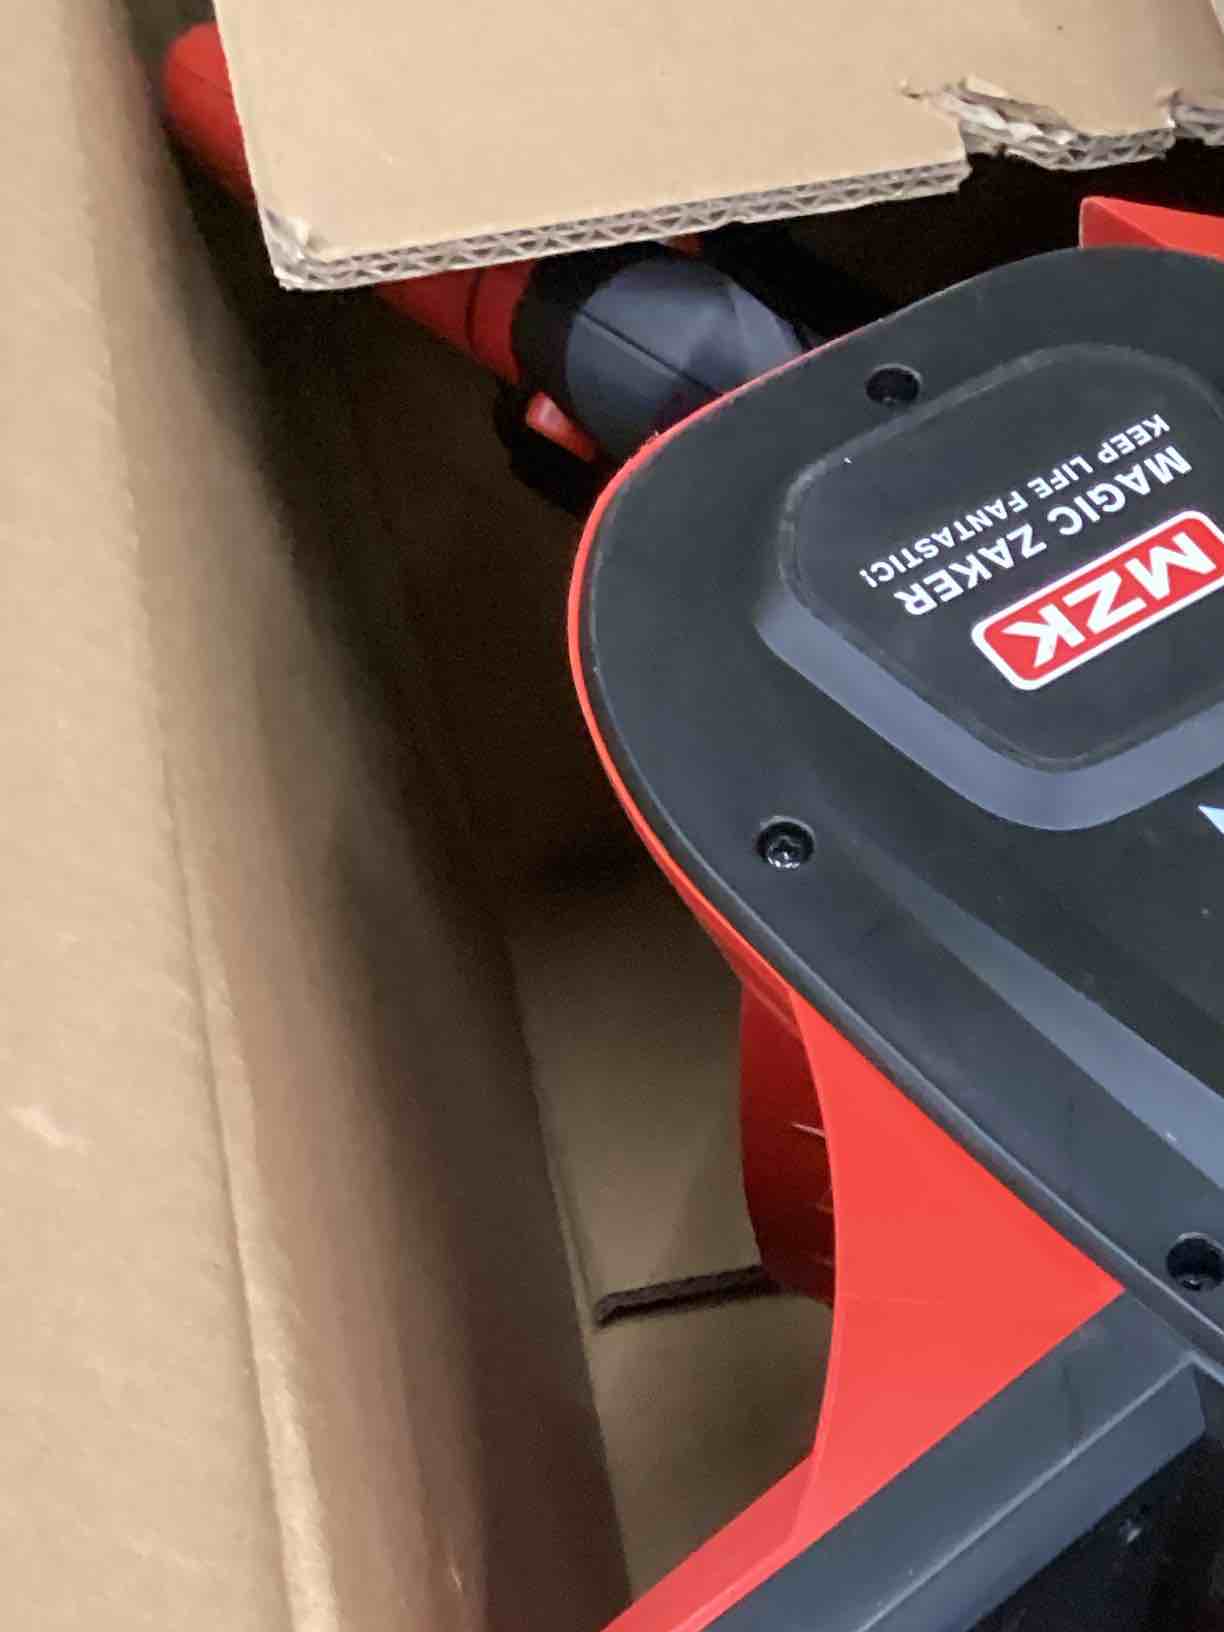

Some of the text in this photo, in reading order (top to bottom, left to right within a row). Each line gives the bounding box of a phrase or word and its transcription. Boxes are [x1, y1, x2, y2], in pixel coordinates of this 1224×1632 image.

[859, 414, 1170, 588] KEEP LIFE FANTASTIC!
[893, 446, 1192, 616] MAGIC ZAKER
[1002, 531, 1217, 668] MZK
